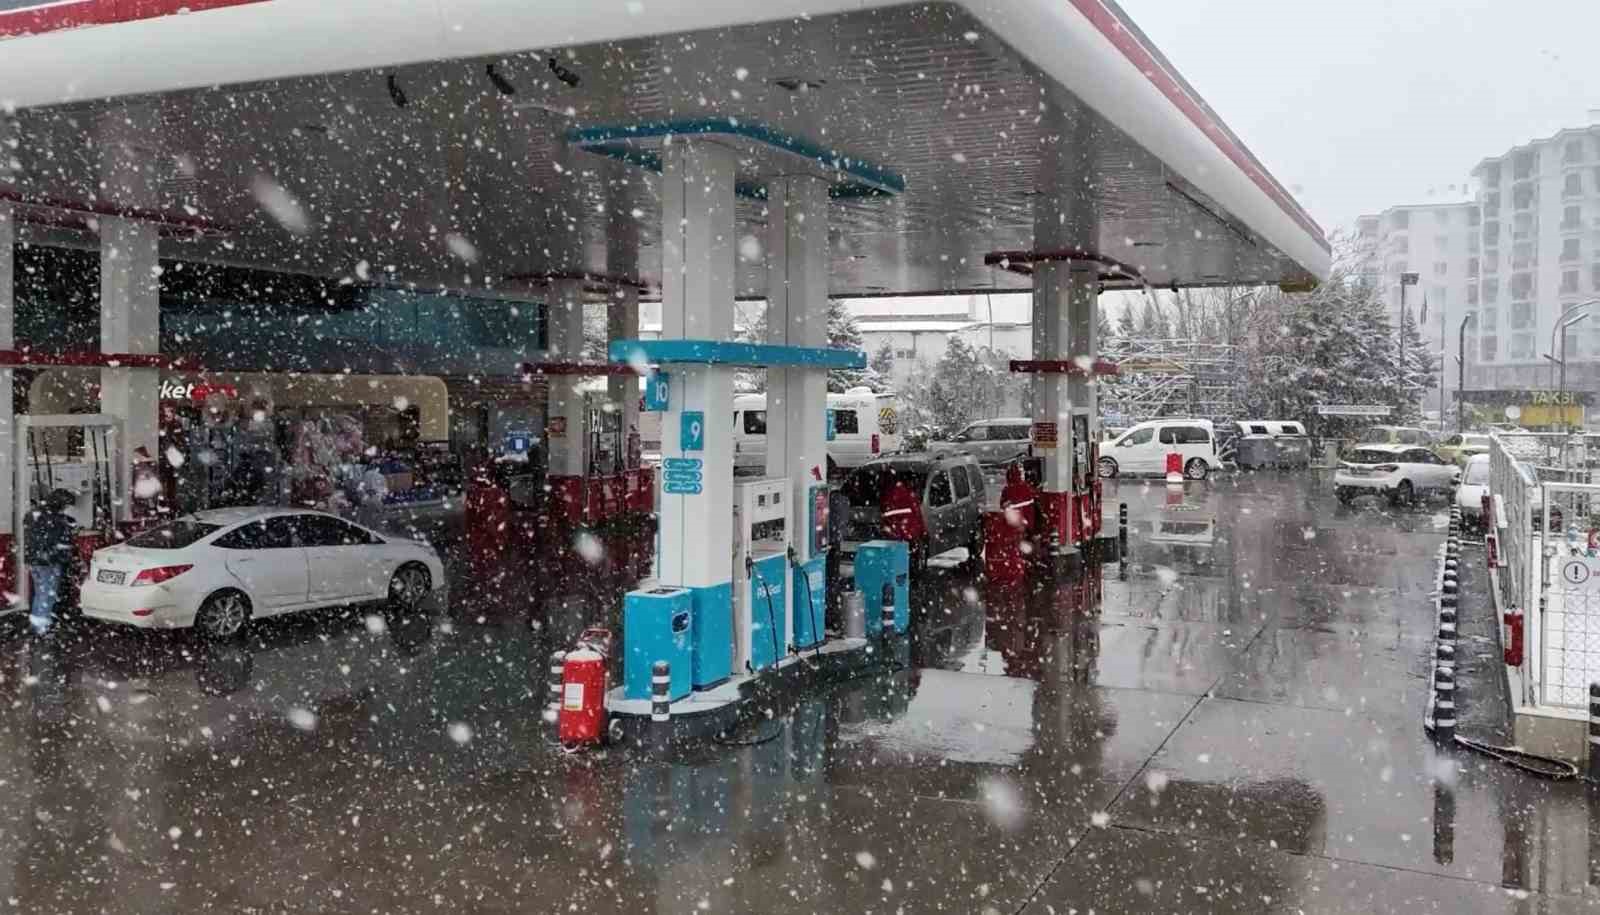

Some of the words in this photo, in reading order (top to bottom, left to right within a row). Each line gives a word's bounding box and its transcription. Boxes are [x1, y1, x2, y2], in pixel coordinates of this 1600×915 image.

[158, 380, 194, 399] ket
[656, 382, 668, 402] 10
[691, 421, 701, 442] 9
